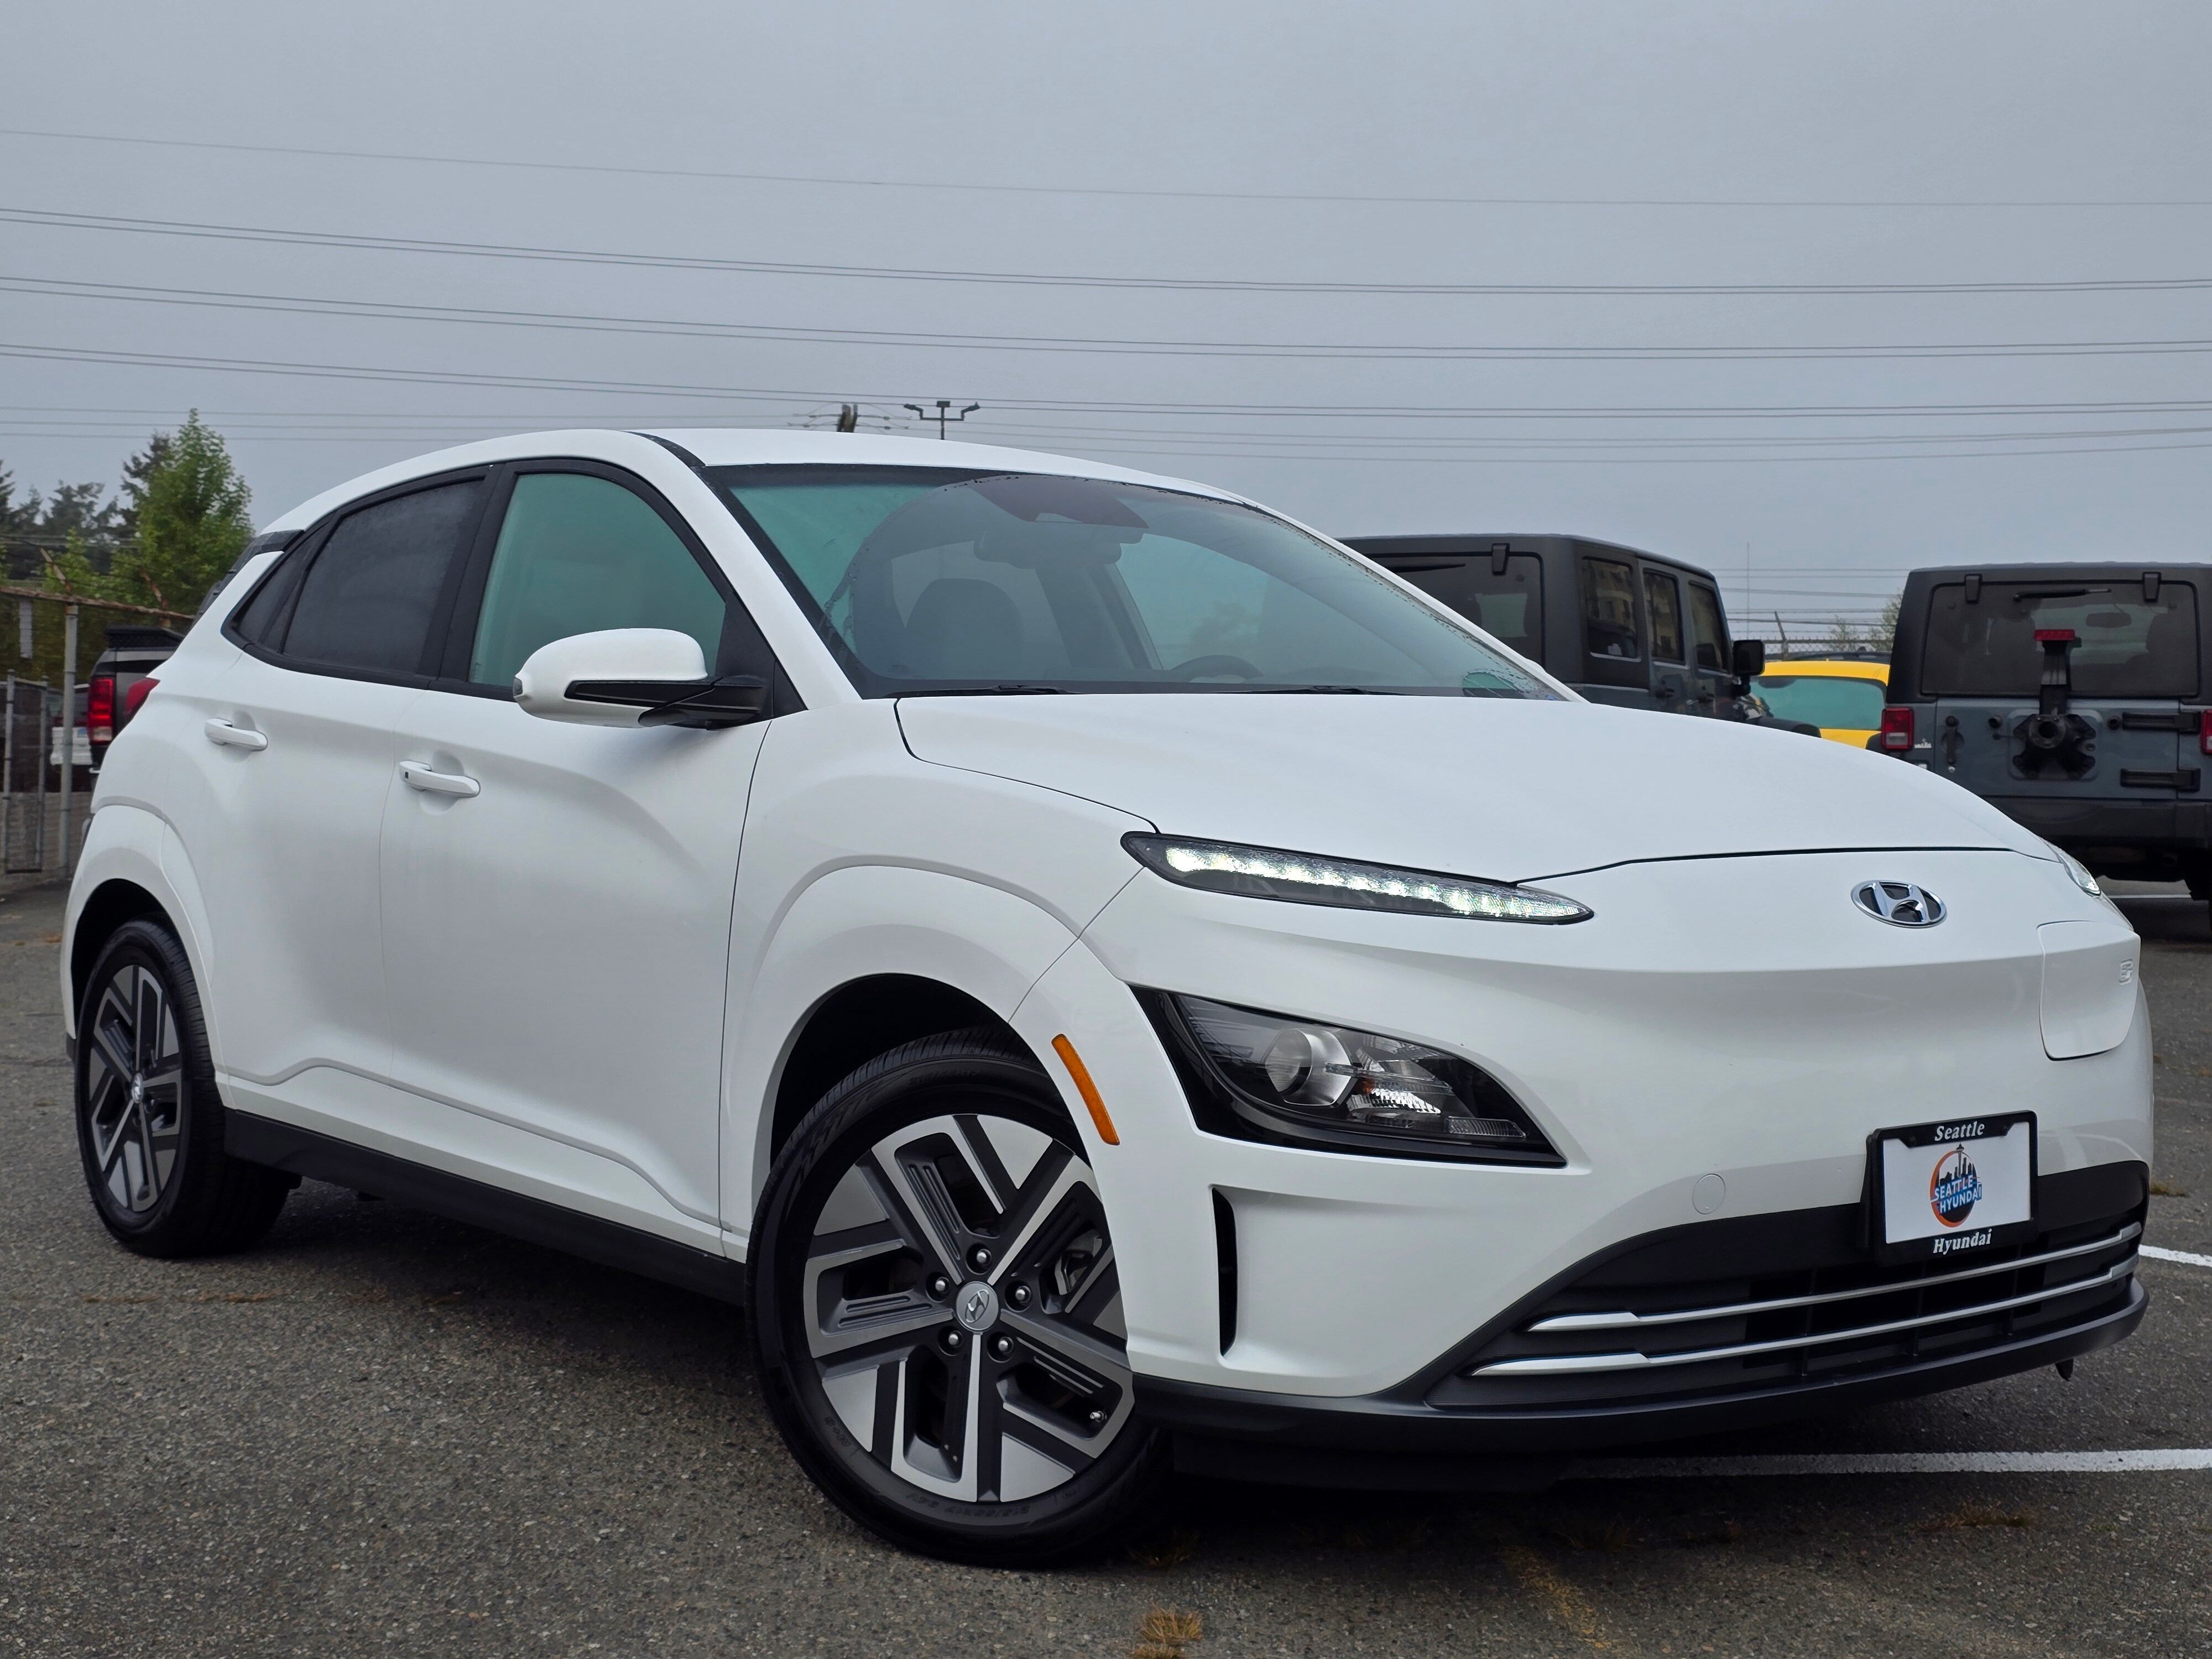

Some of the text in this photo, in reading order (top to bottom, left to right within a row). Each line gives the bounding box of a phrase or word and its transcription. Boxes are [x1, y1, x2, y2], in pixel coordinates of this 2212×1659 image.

[1934, 1121, 1985, 1141] Seattle
[1934, 1175, 1973, 1201] SEATTLE
[1939, 1184, 1982, 1214] HYUNDAI
[1933, 1229, 1992, 1255] Hyundai
